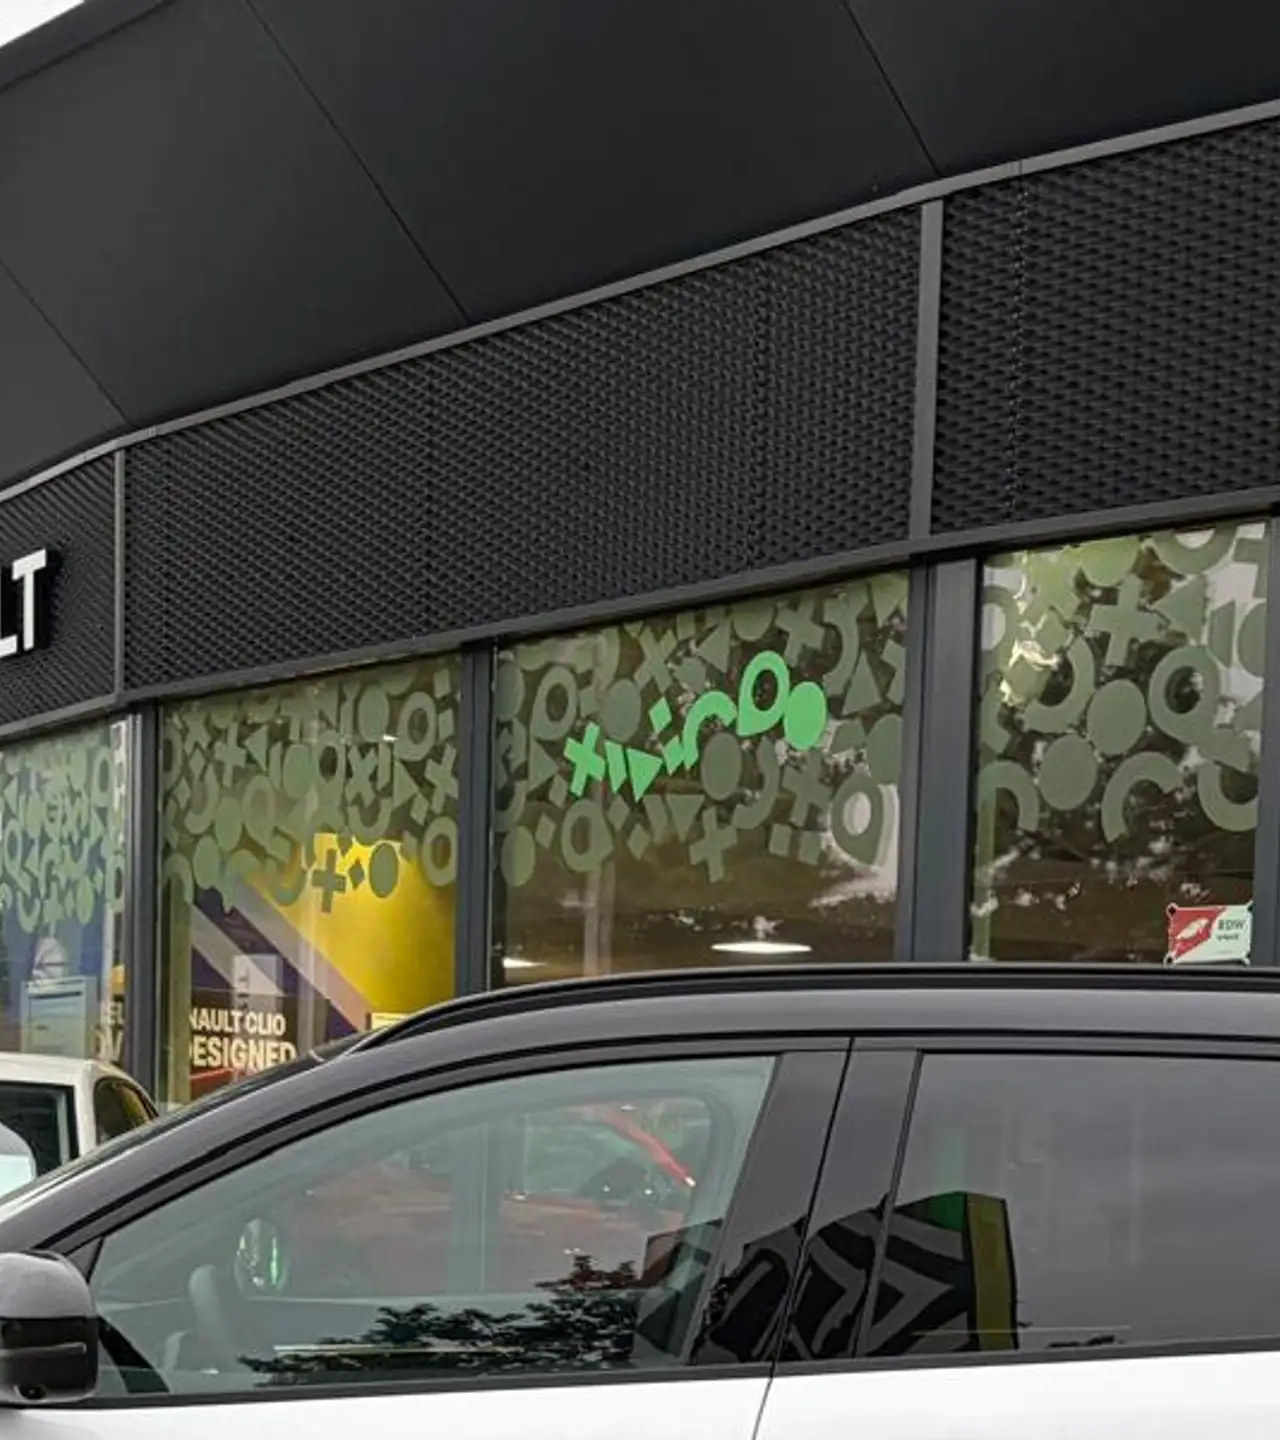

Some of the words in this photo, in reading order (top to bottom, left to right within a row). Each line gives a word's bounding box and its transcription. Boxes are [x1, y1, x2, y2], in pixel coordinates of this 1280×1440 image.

[190, 1008, 243, 1034] NAULT
[245, 1010, 287, 1036] CLIO
[189, 1035, 296, 1072] ESIGNED
